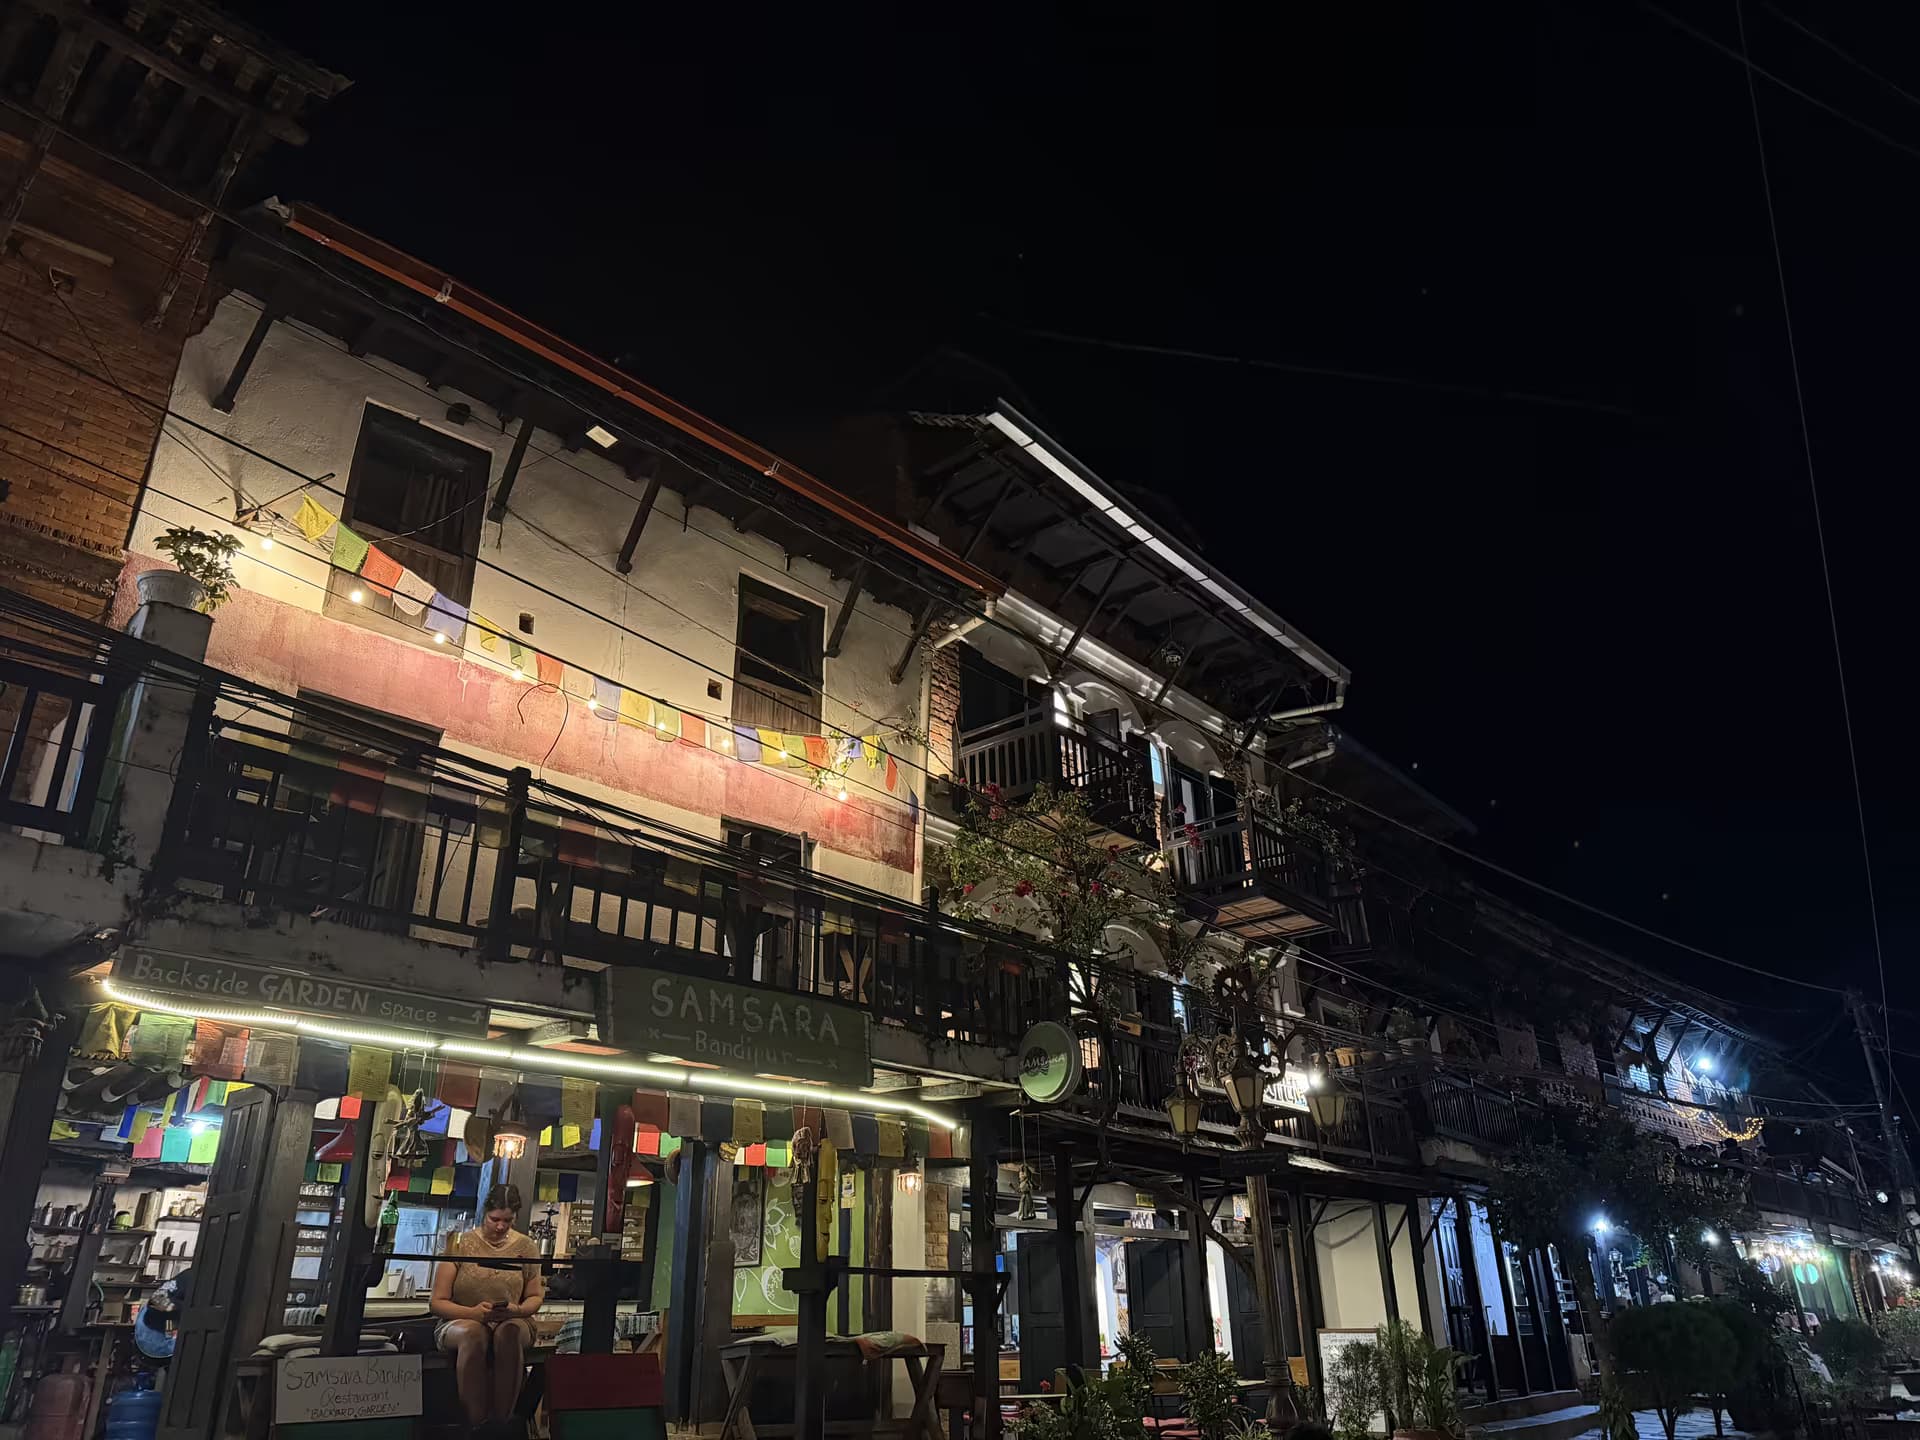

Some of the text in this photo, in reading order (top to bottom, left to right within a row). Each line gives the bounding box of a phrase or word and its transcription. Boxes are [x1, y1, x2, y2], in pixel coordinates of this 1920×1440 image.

[133, 953, 437, 1025] Backside GARDEN space
[650, 977, 840, 1046] SAMSARA
[695, 1030, 793, 1068] Bandipur
[319, 1386, 390, 1408] Restaurant
